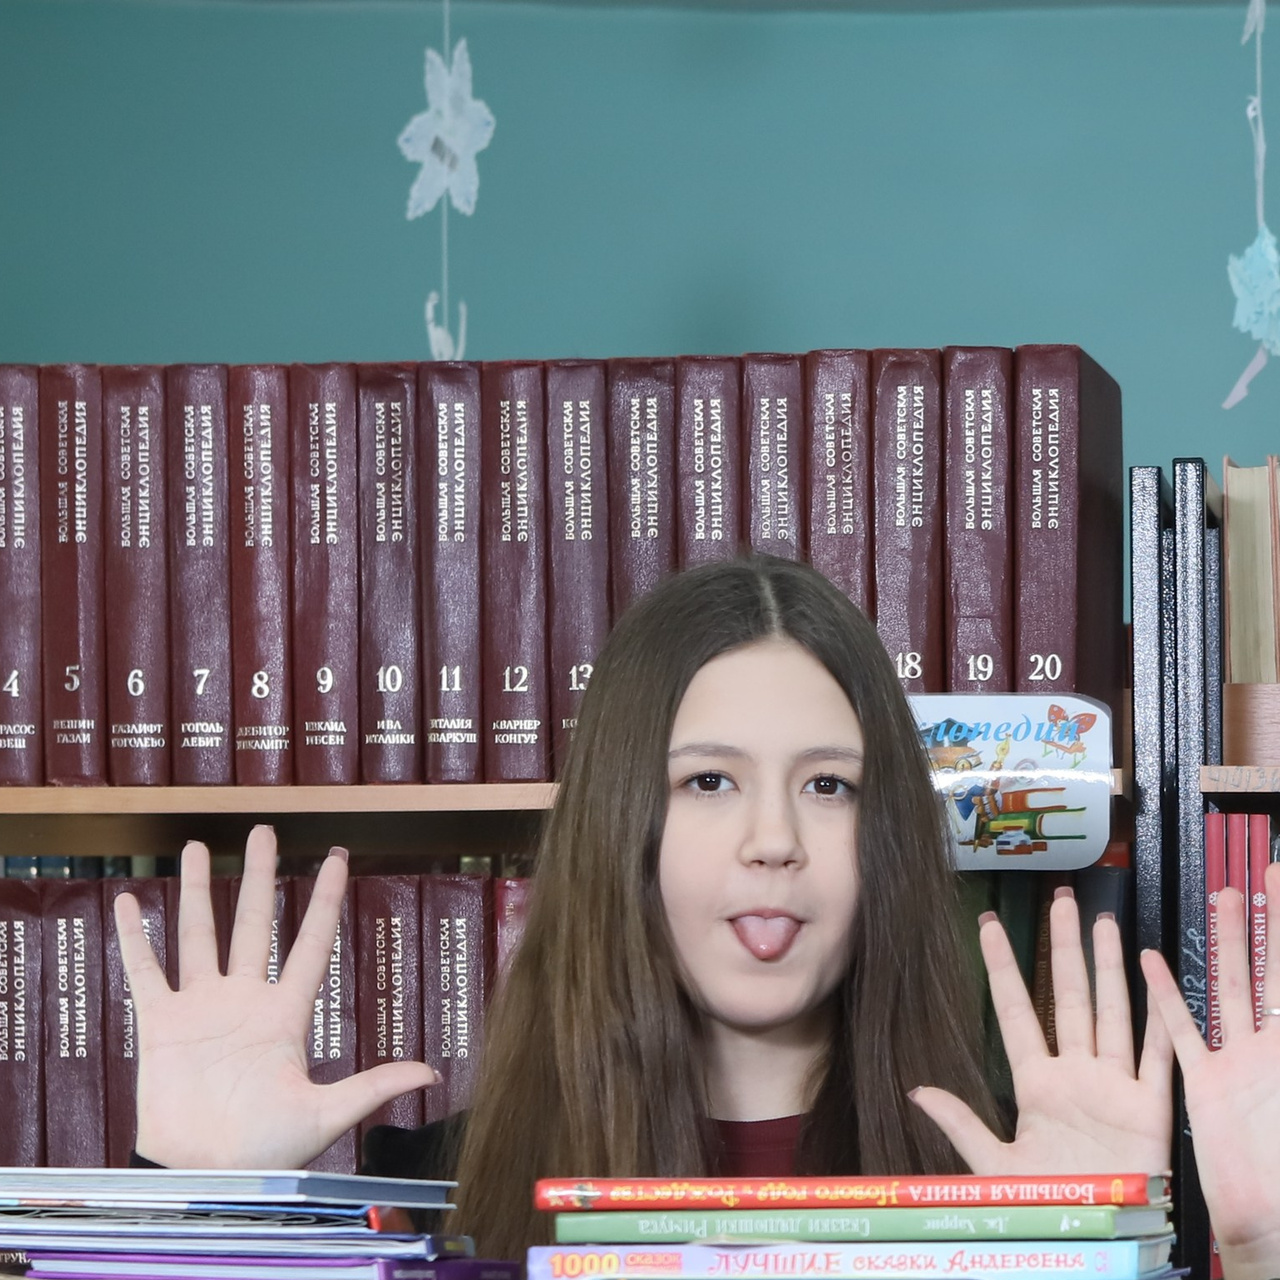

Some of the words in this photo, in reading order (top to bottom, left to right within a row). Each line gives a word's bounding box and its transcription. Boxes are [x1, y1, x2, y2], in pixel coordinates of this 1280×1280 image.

[121, 406, 130, 480] СОВЕТСКАЯ
[185, 405, 195, 479] СОВЕТСКАЯ
[438, 403, 448, 475] СОВЕТСКАЯ
[501, 401, 510, 474] СОВЕТСКАЯ
[694, 399, 704, 473] СОВЕТСКАЯ
[965, 390, 975, 463] СОВЕТСКАЯ
[1032, 389, 1042, 461] СОВЕТСКАЯ
[138, 406, 150, 548] ЭНЦИКЛОПЕДИЯ
[201, 405, 213, 547] ЭНЦИКЛОПЕДИЯ
[454, 403, 464, 542] ЭНЦИКЛОПЕДИЯ
[517, 401, 528, 542] ЭНЦИКЛОПЕДИЯ
[711, 399, 722, 540] ЭНЦИКЛОПЕДИЯ
[982, 390, 992, 530] ЭНЦИКЛОПЕДИЯ
[1048, 389, 1059, 529] ЭНЦИКЛОПЕДИЯ
[122, 487, 130, 547] БОЛЬШАЯ
[186, 486, 195, 546] БОЛЬШАЯ
[439, 482, 448, 542] БОЛЬШАЯ
[502, 482, 511, 542] БОЛЬШАЯ
[696, 480, 704, 540] БОЛЬШАЯ
[966, 470, 975, 529] БОЛЬШАЯ
[1032, 470, 1042, 528] БОЛЬШАЯ
[3, 670, 19, 697] 4
[64, 665, 80, 691] 5
[127, 669, 145, 696] 6
[193, 669, 210, 695] 7
[252, 671, 270, 698] 8
[316, 667, 333, 693] 9
[376, 665, 402, 692] 10
[440, 665, 462, 691] 11
[503, 666, 528, 692] 12
[569, 664, 593, 691] 13
[895, 652, 922, 679] 18
[967, 654, 993, 681] 19
[1029, 654, 1062, 681] 20
[57, 734, 90, 743] ГАЗЛИ
[112, 724, 163, 734] ГАЗЛИФТ
[181, 722, 223, 733] ГОГОЛЬ
[181, 737, 222, 748] ДЕБИТ
[237, 726, 289, 736] ДЕБИТОР
[306, 734, 344, 745] ИБСЕН
[366, 734, 415, 744] ИТАЛИКИ
[428, 733, 476, 743] КВАРКУШ
[430, 719, 472, 728] ИТАЛИЯ
[493, 719, 540, 730] КВАРНЕР
[495, 734, 538, 744] КОНГУР
[57, 919, 67, 991] СОВЕТСКАЯ
[376, 918, 386, 990] СОВЕТСКАЯ
[440, 918, 449, 990] СОВЕТСКАЯ
[74, 918, 86, 1057] ЭНЦИКЛОПЕДИЯ
[391, 917, 402, 1058] ЭНЦИКЛОПЕДИЯ
[456, 918, 467, 1058] ЭНЦИКЛОПЕДИЯ
[60, 997, 69, 1057] БОЛЬШАЯ
[377, 998, 386, 1057] БОЛЬШАЯ
[442, 999, 450, 1057] БОЛЬШАЯ
[550, 1252, 620, 1278] 1000
[707, 1252, 843, 1274] ЛУЧШИЕ
